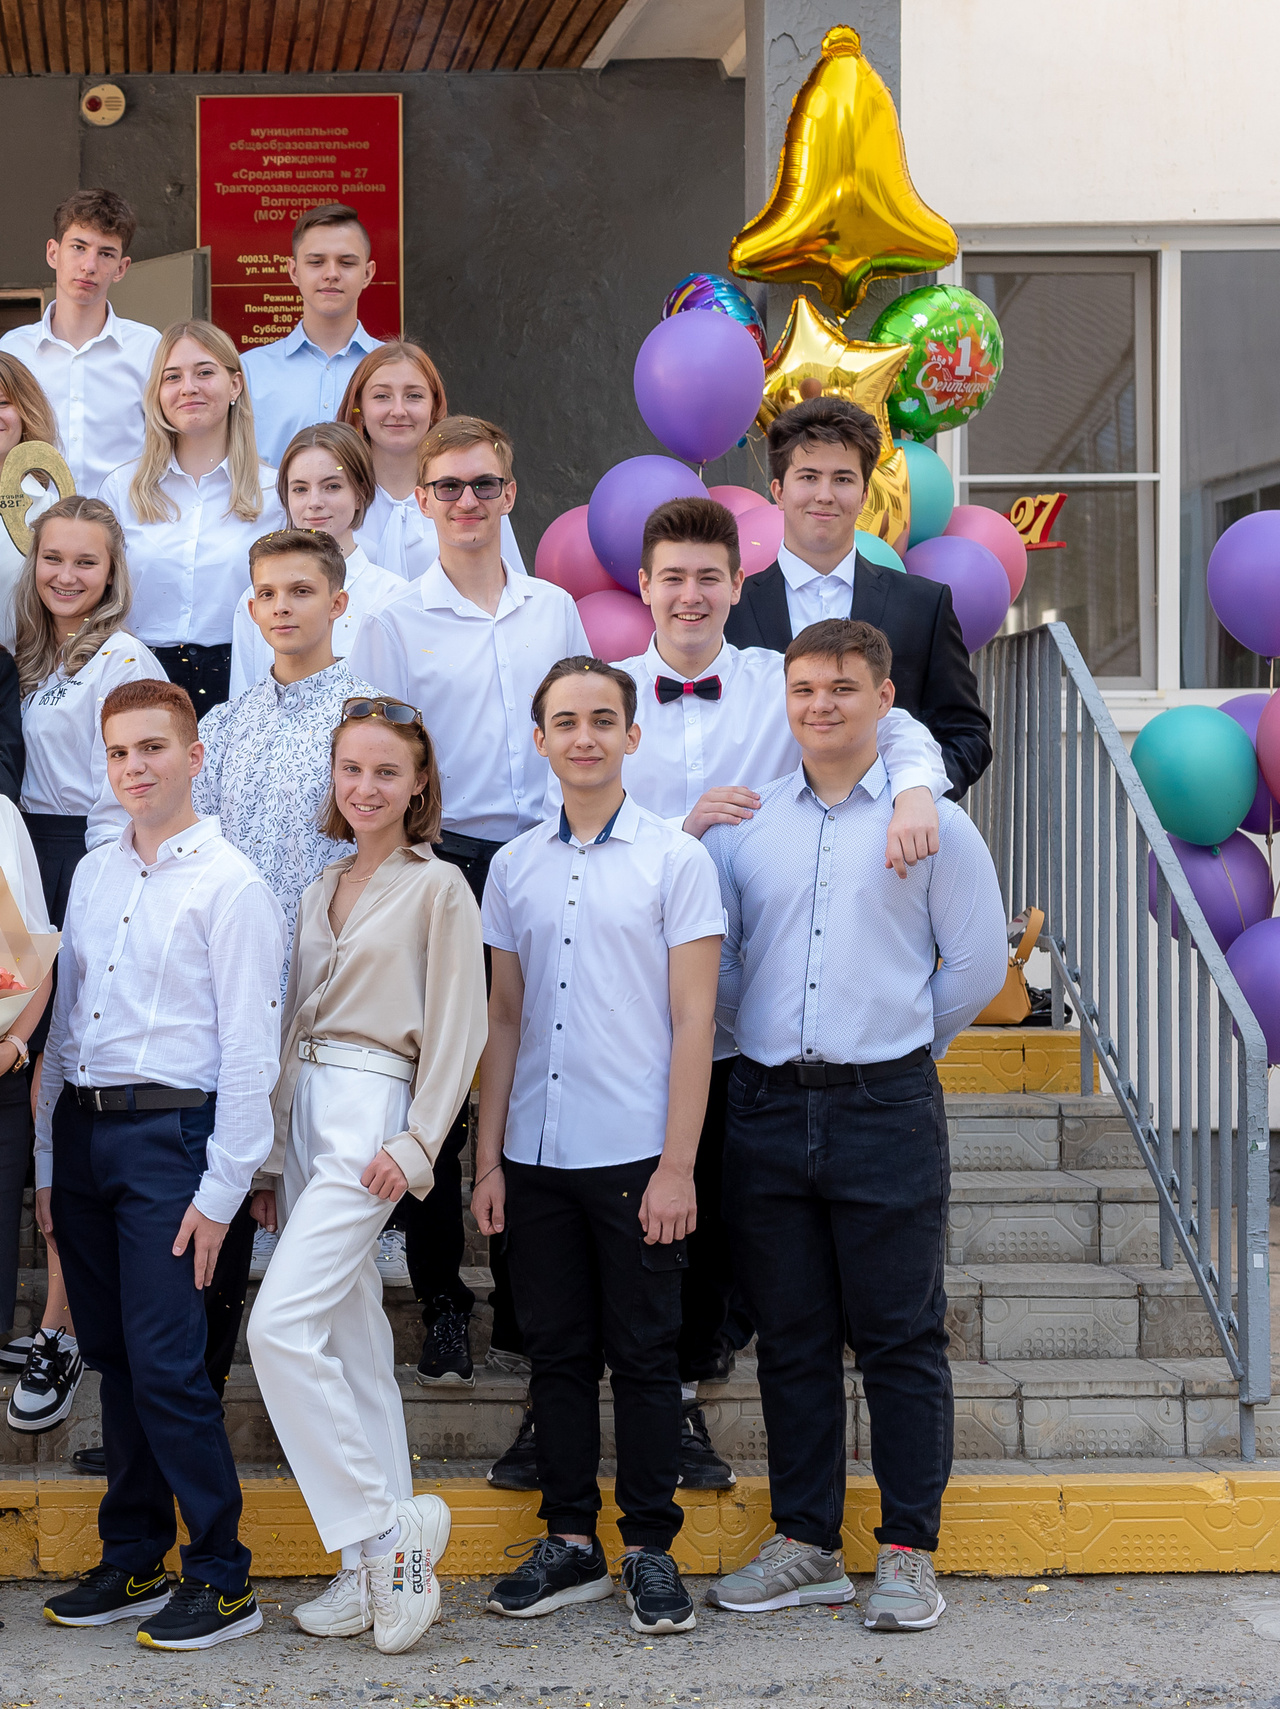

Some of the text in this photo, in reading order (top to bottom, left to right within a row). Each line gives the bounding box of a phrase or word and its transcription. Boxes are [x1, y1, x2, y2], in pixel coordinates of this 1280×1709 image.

[250, 127, 349, 139] муниципальное
[229, 139, 370, 152] общеобразовательное
[262, 154, 337, 166] учреждение
[232, 168, 293, 181] «Средняя
[296, 170, 334, 179] школа
[354, 168, 368, 178] 27
[214, 182, 386, 195] Тракторозаводского района
[253, 210, 286, 223] (МОУ
[237, 254, 271, 264] 400033,
[245, 266, 260, 276] ул.
[263, 293, 294, 302] Режим
[244, 304, 304, 313] Понедельни
[273, 314, 293, 323] 8:00
[252, 324, 292, 335] Суббота
[955, 336, 972, 376] 1
[1010, 492, 1062, 544] 27
[412, 1548, 423, 1594] GUCCI
